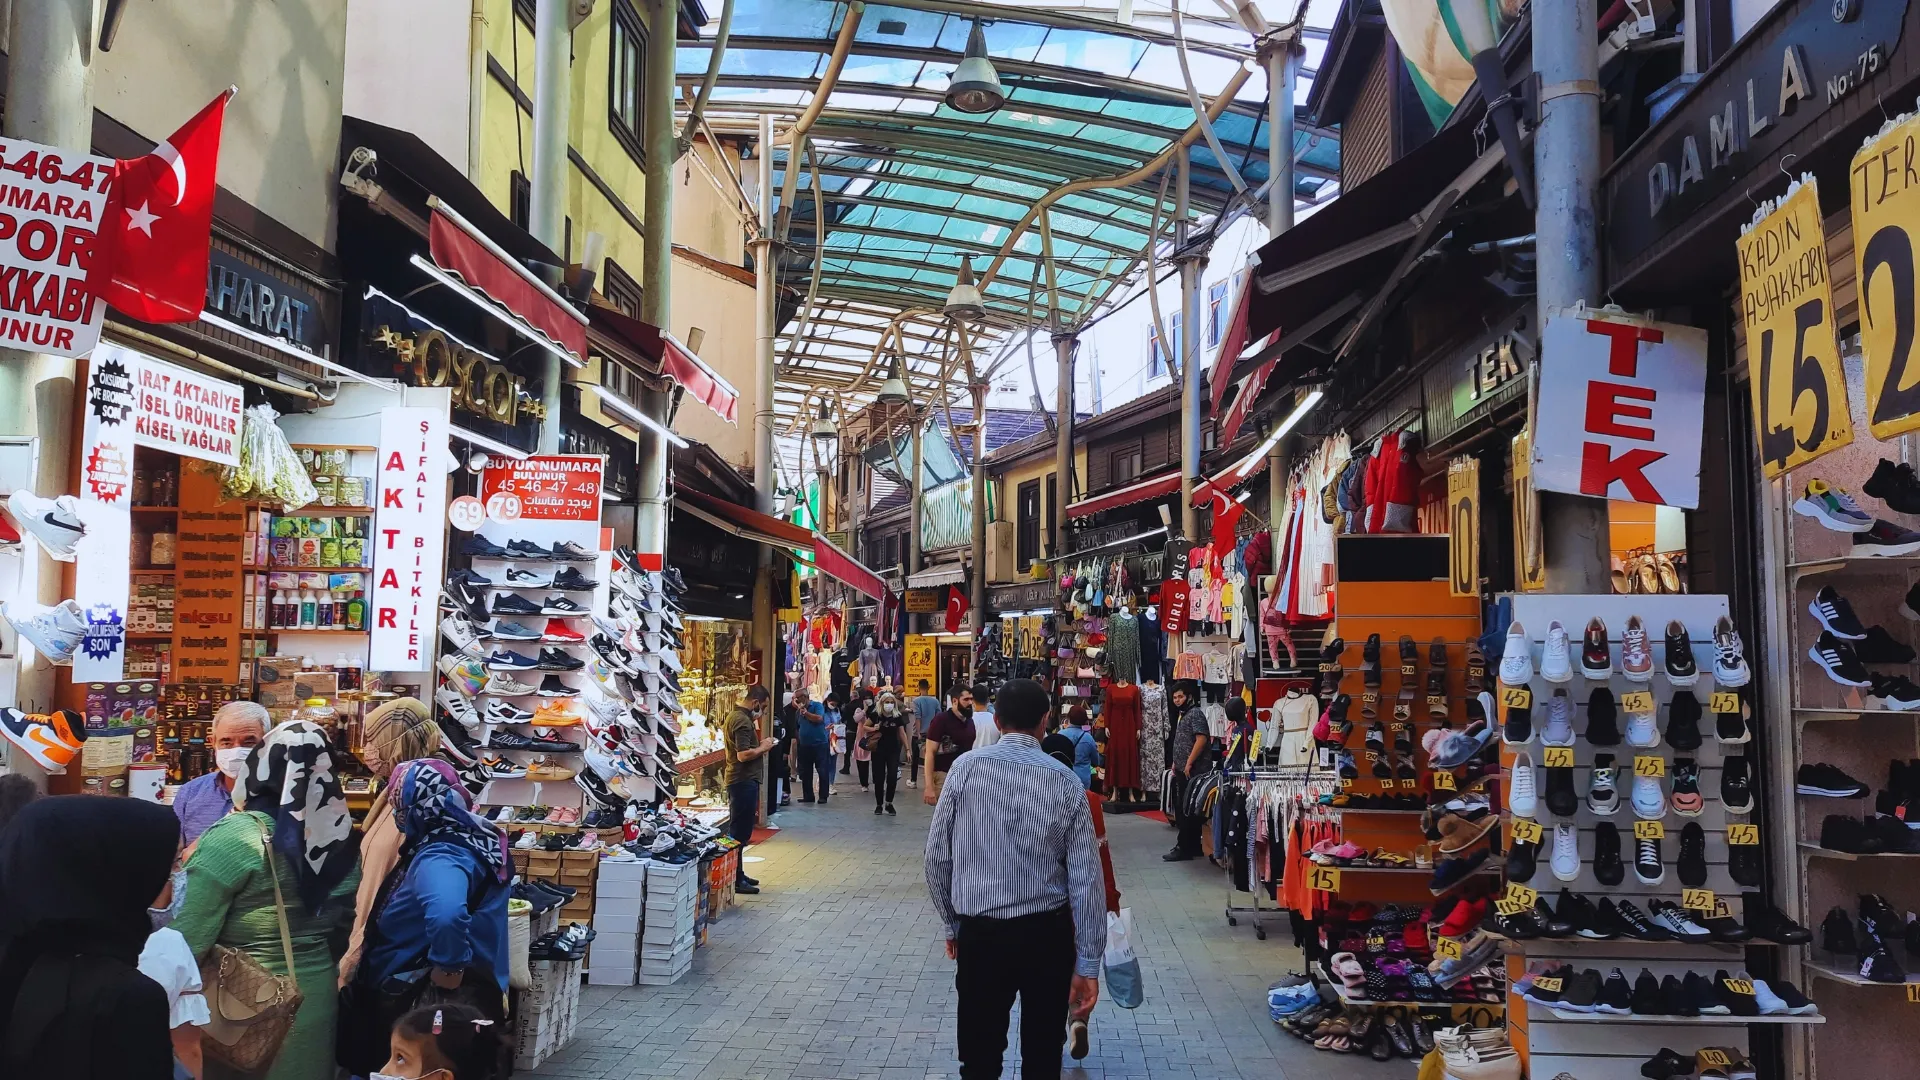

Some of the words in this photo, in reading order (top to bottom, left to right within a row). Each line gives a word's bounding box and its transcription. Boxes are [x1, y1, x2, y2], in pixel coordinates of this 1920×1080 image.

[1858, 44, 1880, 80] 75
[1650, 45, 1811, 218] DAMLA
[1741, 210, 1800, 282] KADIN
[1746, 245, 1825, 328] AYAKKABI
[1465, 335, 1524, 401] TEK
[1761, 298, 1829, 469] 45
[173, 380, 241, 414] AKTARİYE
[175, 400, 236, 435] ÜRÜNLER
[1580, 320, 1669, 505] TEK
[181, 427, 232, 456] YAĞLAR
[417, 421, 429, 513] ŞİFALI
[540, 460, 601, 472] NUMARA
[513, 471, 566, 481] BULUNUR
[492, 497, 518, 518] 79
[378, 451, 405, 629] AKTAR
[1452, 496, 1472, 594] 10
[1171, 553, 1187, 580] RLS
[408, 537, 424, 660] BİTKİLER
[179, 610, 232, 623] aksu
[1167, 592, 1185, 631] GIRLS
[90, 638, 110, 651] SON
[1504, 690, 1526, 707] 45
[1625, 696, 1643, 710] 45
[1713, 694, 1735, 711] 45
[1547, 750, 1567, 767] 45
[1636, 760, 1659, 776] 45
[1437, 773, 1454, 787] 15
[1513, 822, 1534, 840] 45
[1637, 823, 1658, 837] 45
[1730, 826, 1754, 844] 45
[1311, 871, 1334, 890] 15
[1511, 885, 1533, 904] 45
[1685, 890, 1704, 907] 45
[1440, 939, 1456, 956] 15
[1727, 980, 1752, 995] 119
[1706, 1051, 1724, 1064] 40
